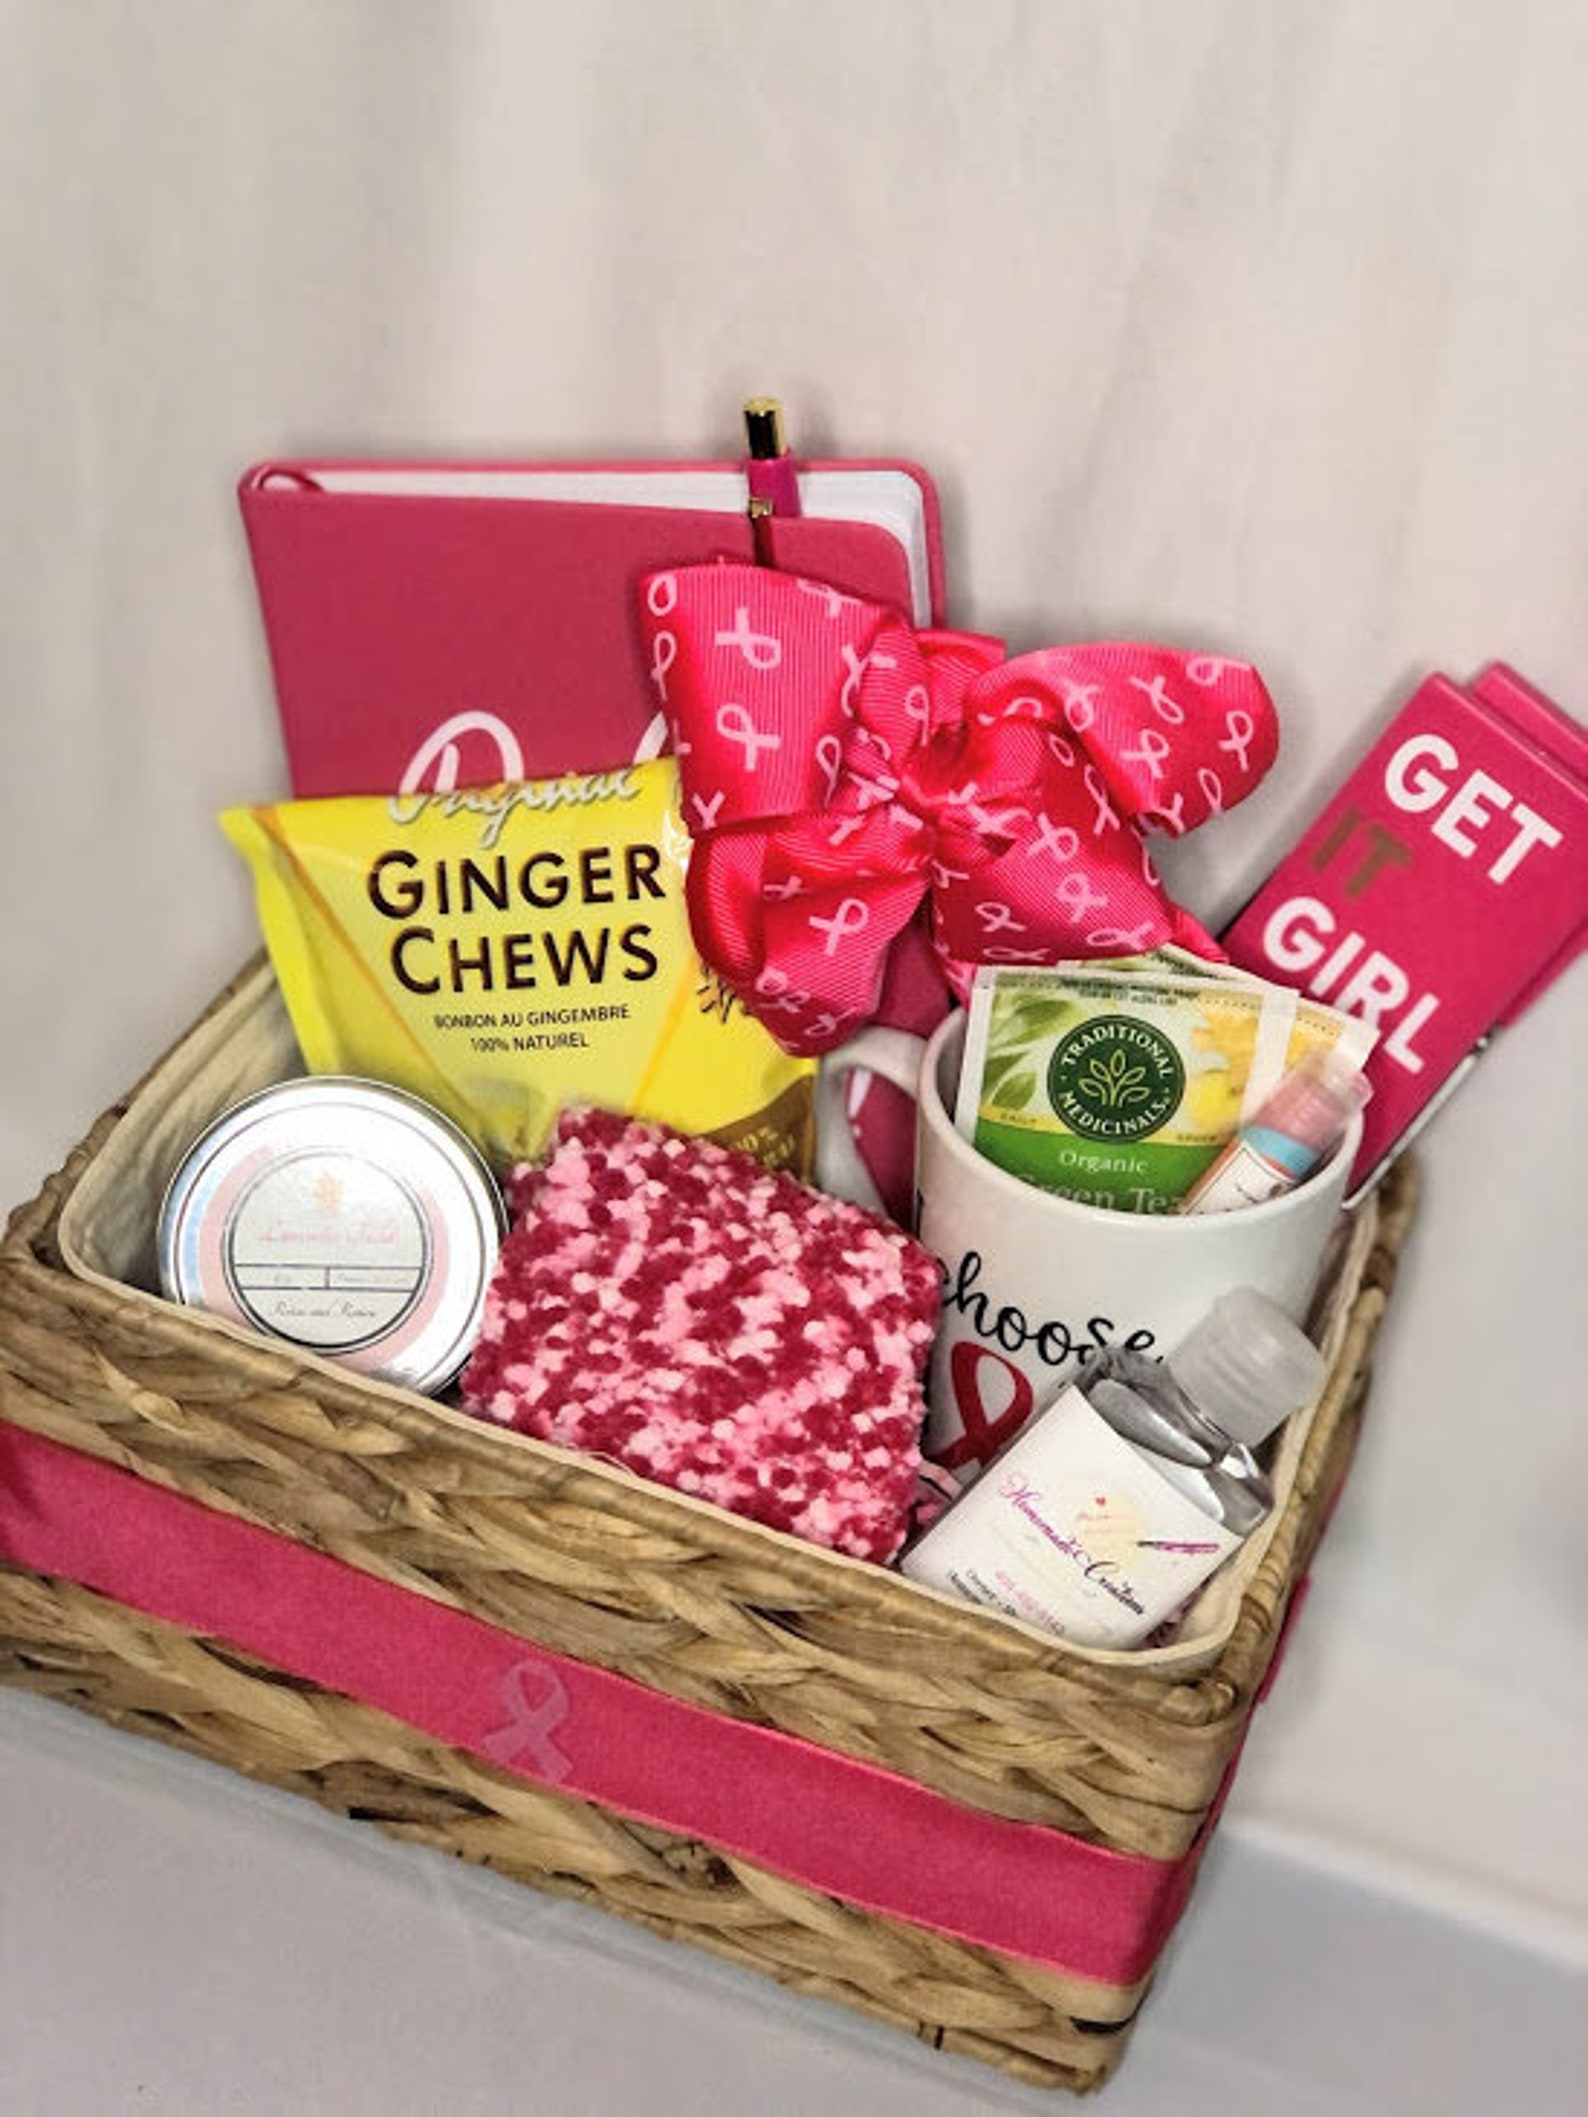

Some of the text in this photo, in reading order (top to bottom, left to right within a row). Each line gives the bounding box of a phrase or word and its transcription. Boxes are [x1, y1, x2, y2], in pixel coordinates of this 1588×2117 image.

[1385, 734, 1564, 885] GET
[367, 843, 667, 919] GINGER
[1312, 808, 1410, 898] IT
[390, 923, 659, 995] CHEWS
[1263, 897, 1441, 1075] GIRL
[433, 1004, 631, 1030] BONBON AU GINGEMBRE
[470, 1032, 590, 1053] 100% NATUREL
[1061, 1024, 1174, 1080] TRADITIONAL
[1058, 1149, 1151, 1174] Organic
[936, 1251, 1165, 1367] hoose
